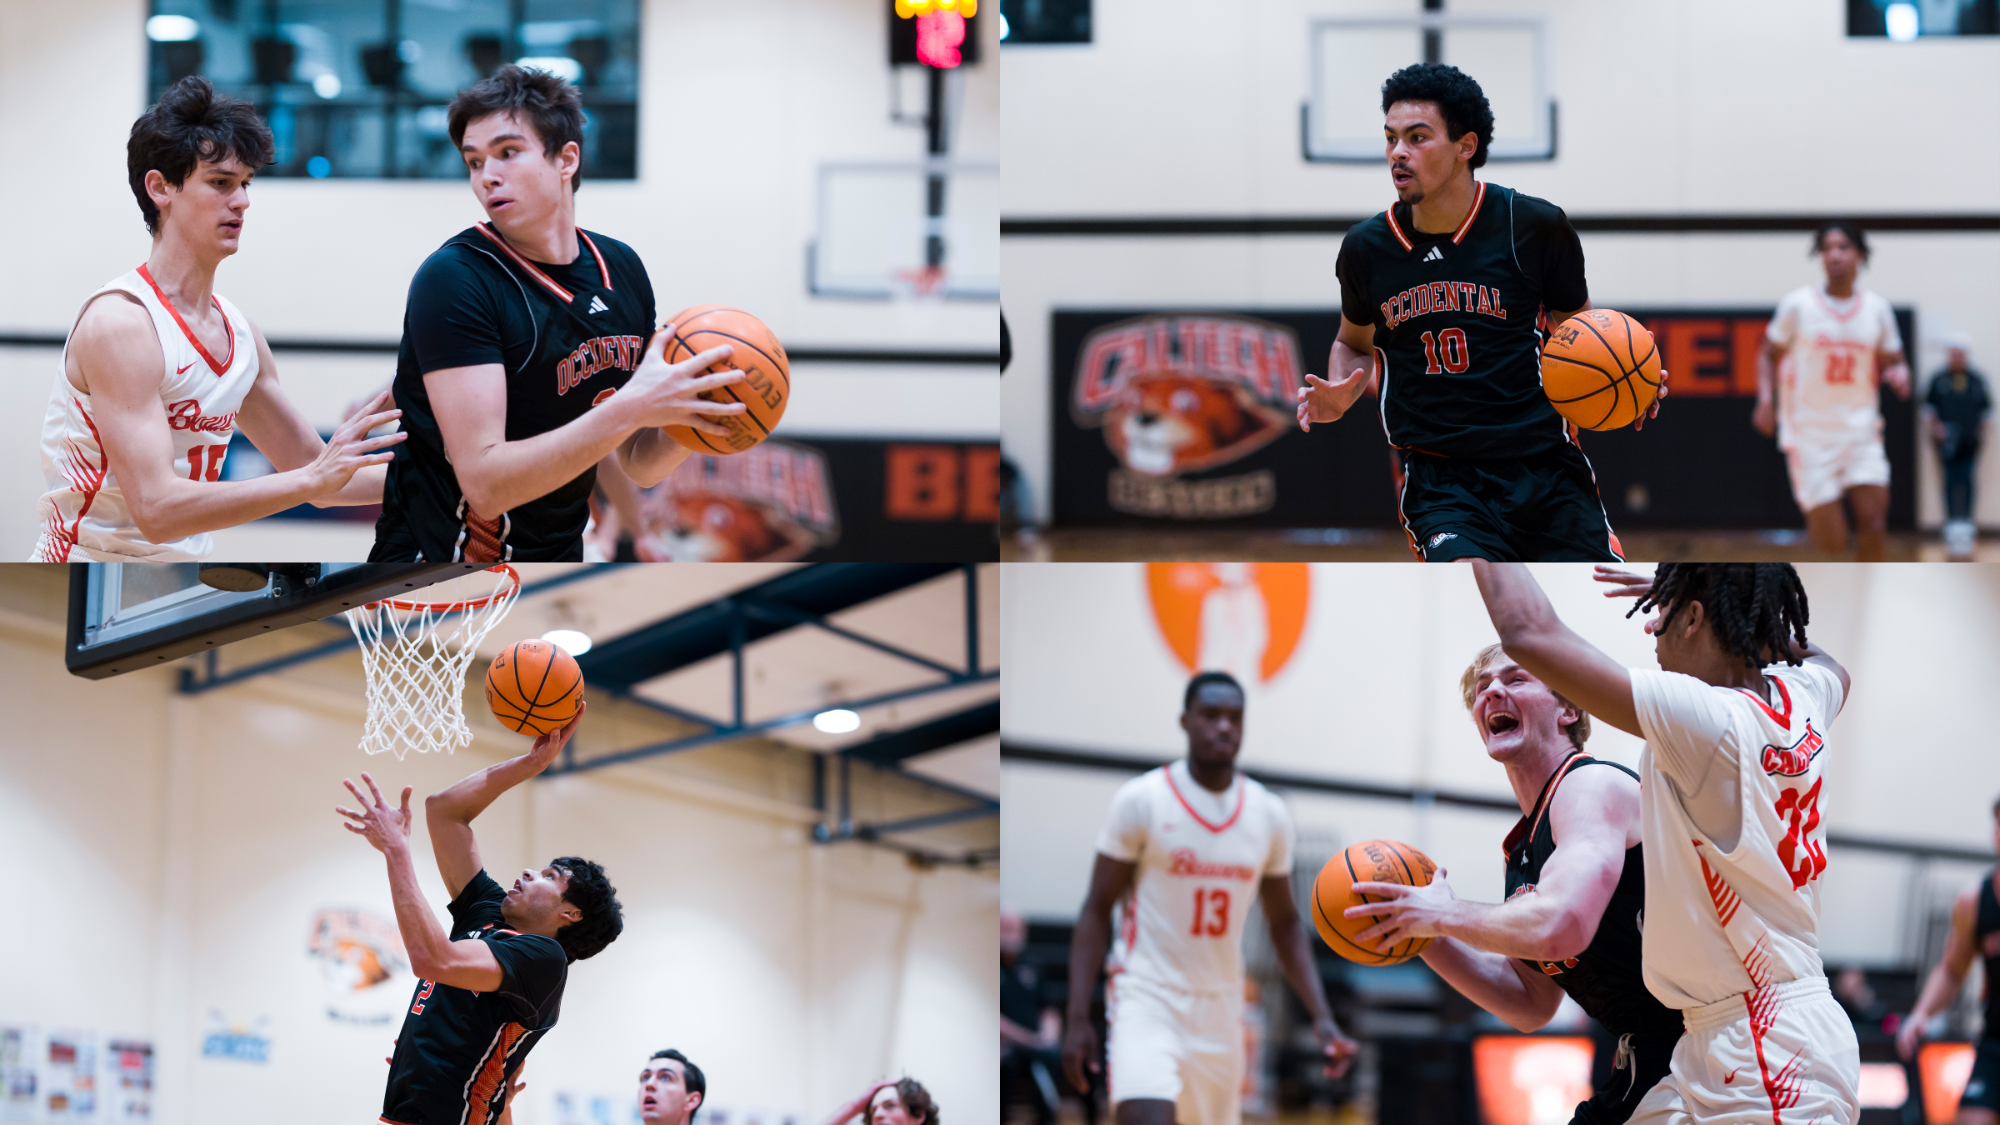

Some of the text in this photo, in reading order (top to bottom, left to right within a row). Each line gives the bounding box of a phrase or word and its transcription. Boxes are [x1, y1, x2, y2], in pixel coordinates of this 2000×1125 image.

[1381, 281, 1506, 330] OCCIDENTAL
[1420, 327, 1470, 375] 10
[1551, 325, 1581, 346] CAA
[1774, 775, 1827, 891] 22
[1190, 886, 1232, 938] 13
